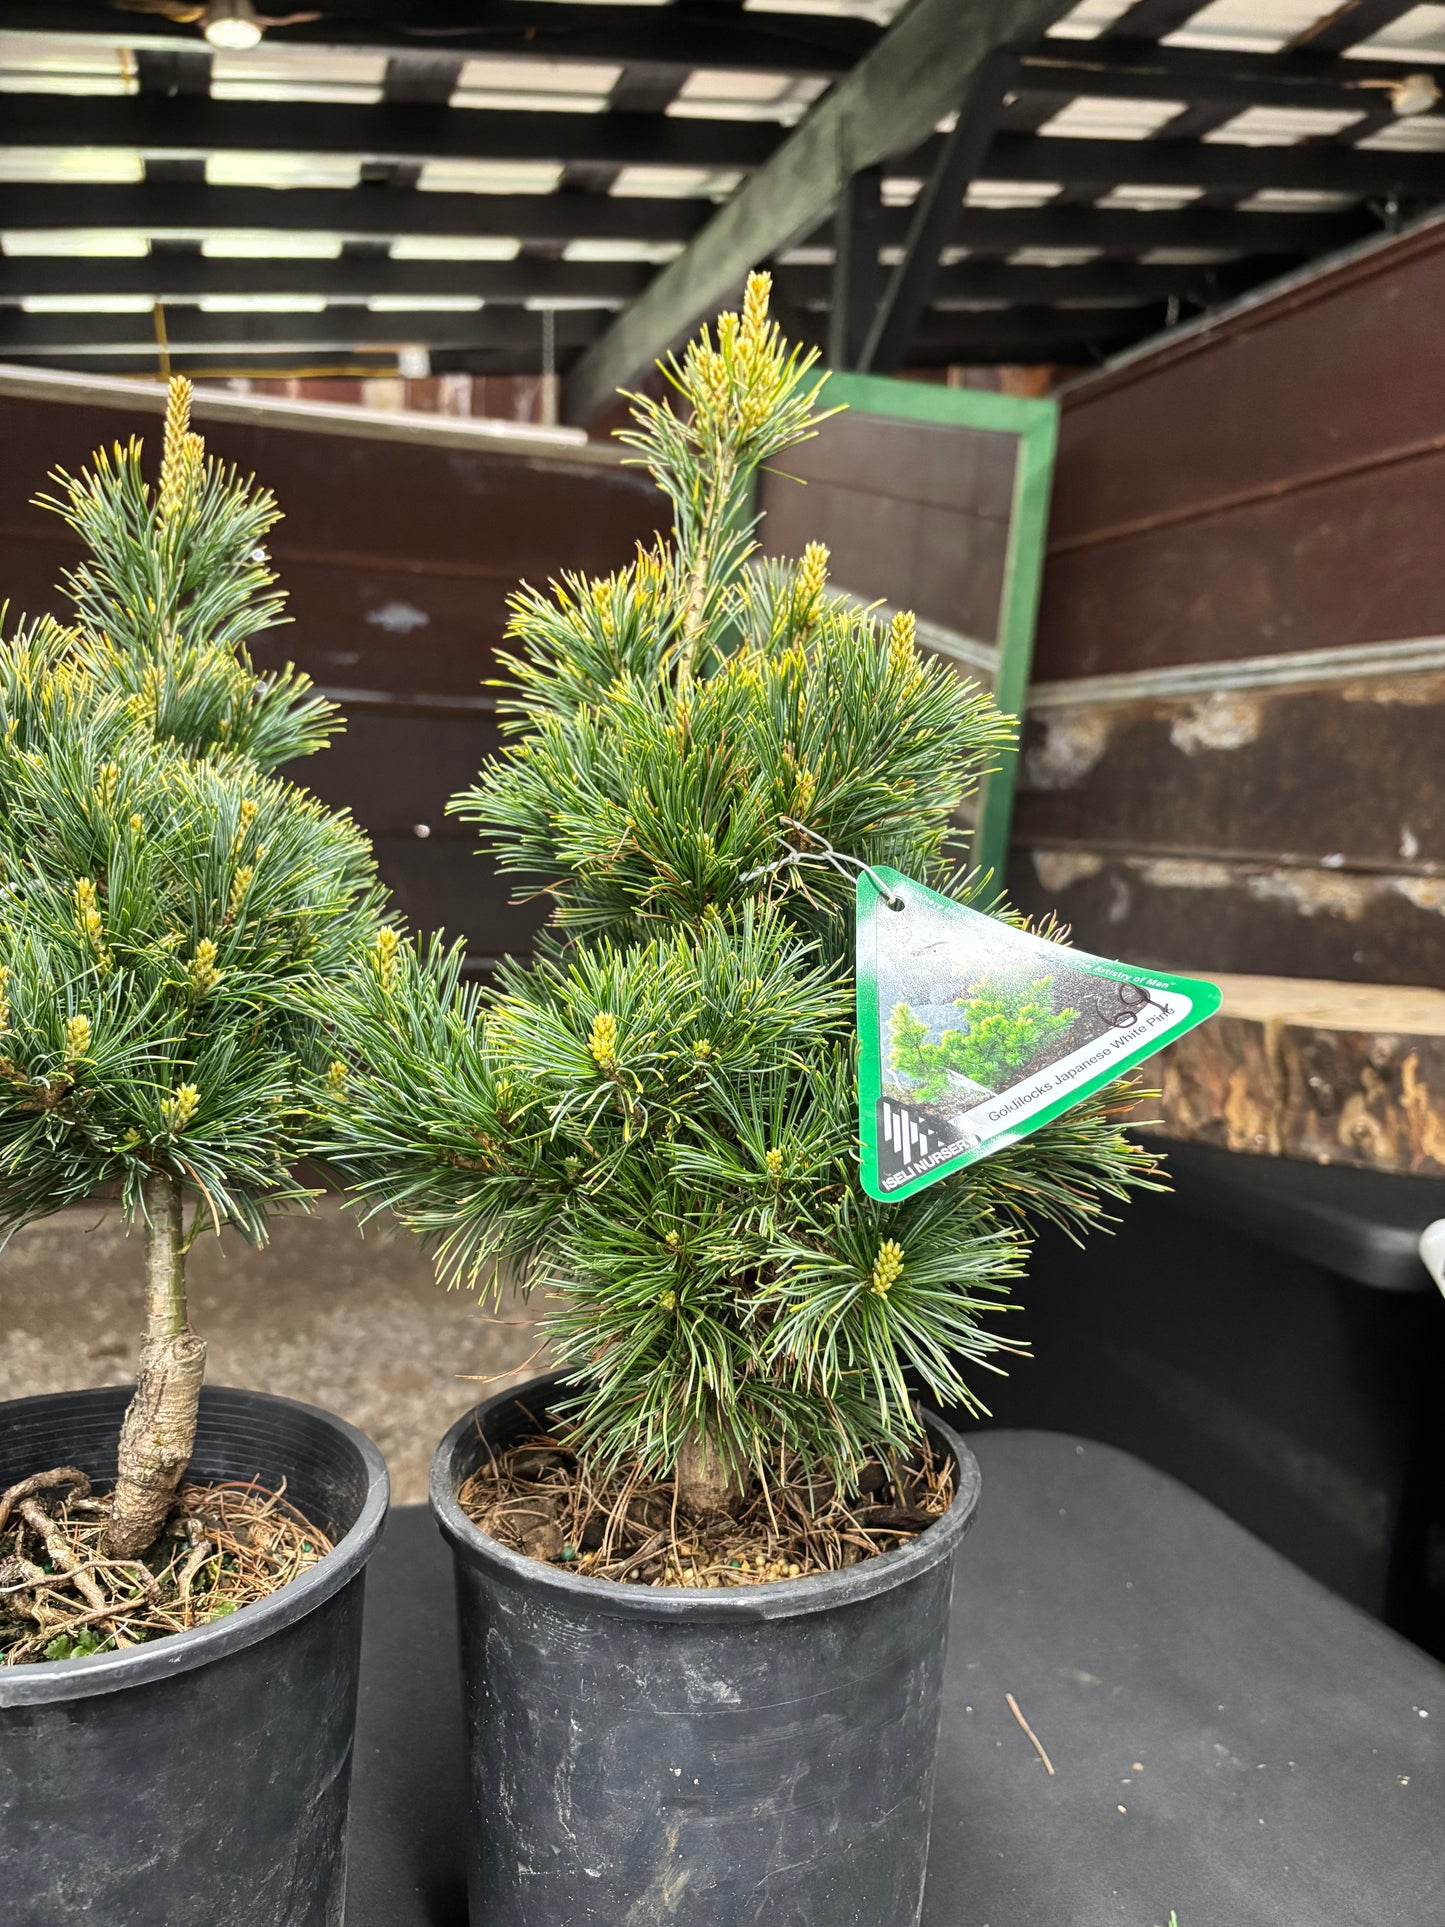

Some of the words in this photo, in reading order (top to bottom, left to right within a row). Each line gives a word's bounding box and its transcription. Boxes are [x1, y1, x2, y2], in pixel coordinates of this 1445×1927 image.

[1094, 965, 1132, 982] Artistry
[1133, 975, 1145, 984] of
[1146, 978, 1169, 989] Man
[988, 1082, 1053, 1122] Goldilocks
[1055, 1048, 1112, 1086] Japanese
[1110, 1024, 1147, 1050] White
[1146, 1007, 1176, 1027] Pine
[882, 1167, 917, 1191] ISELI
